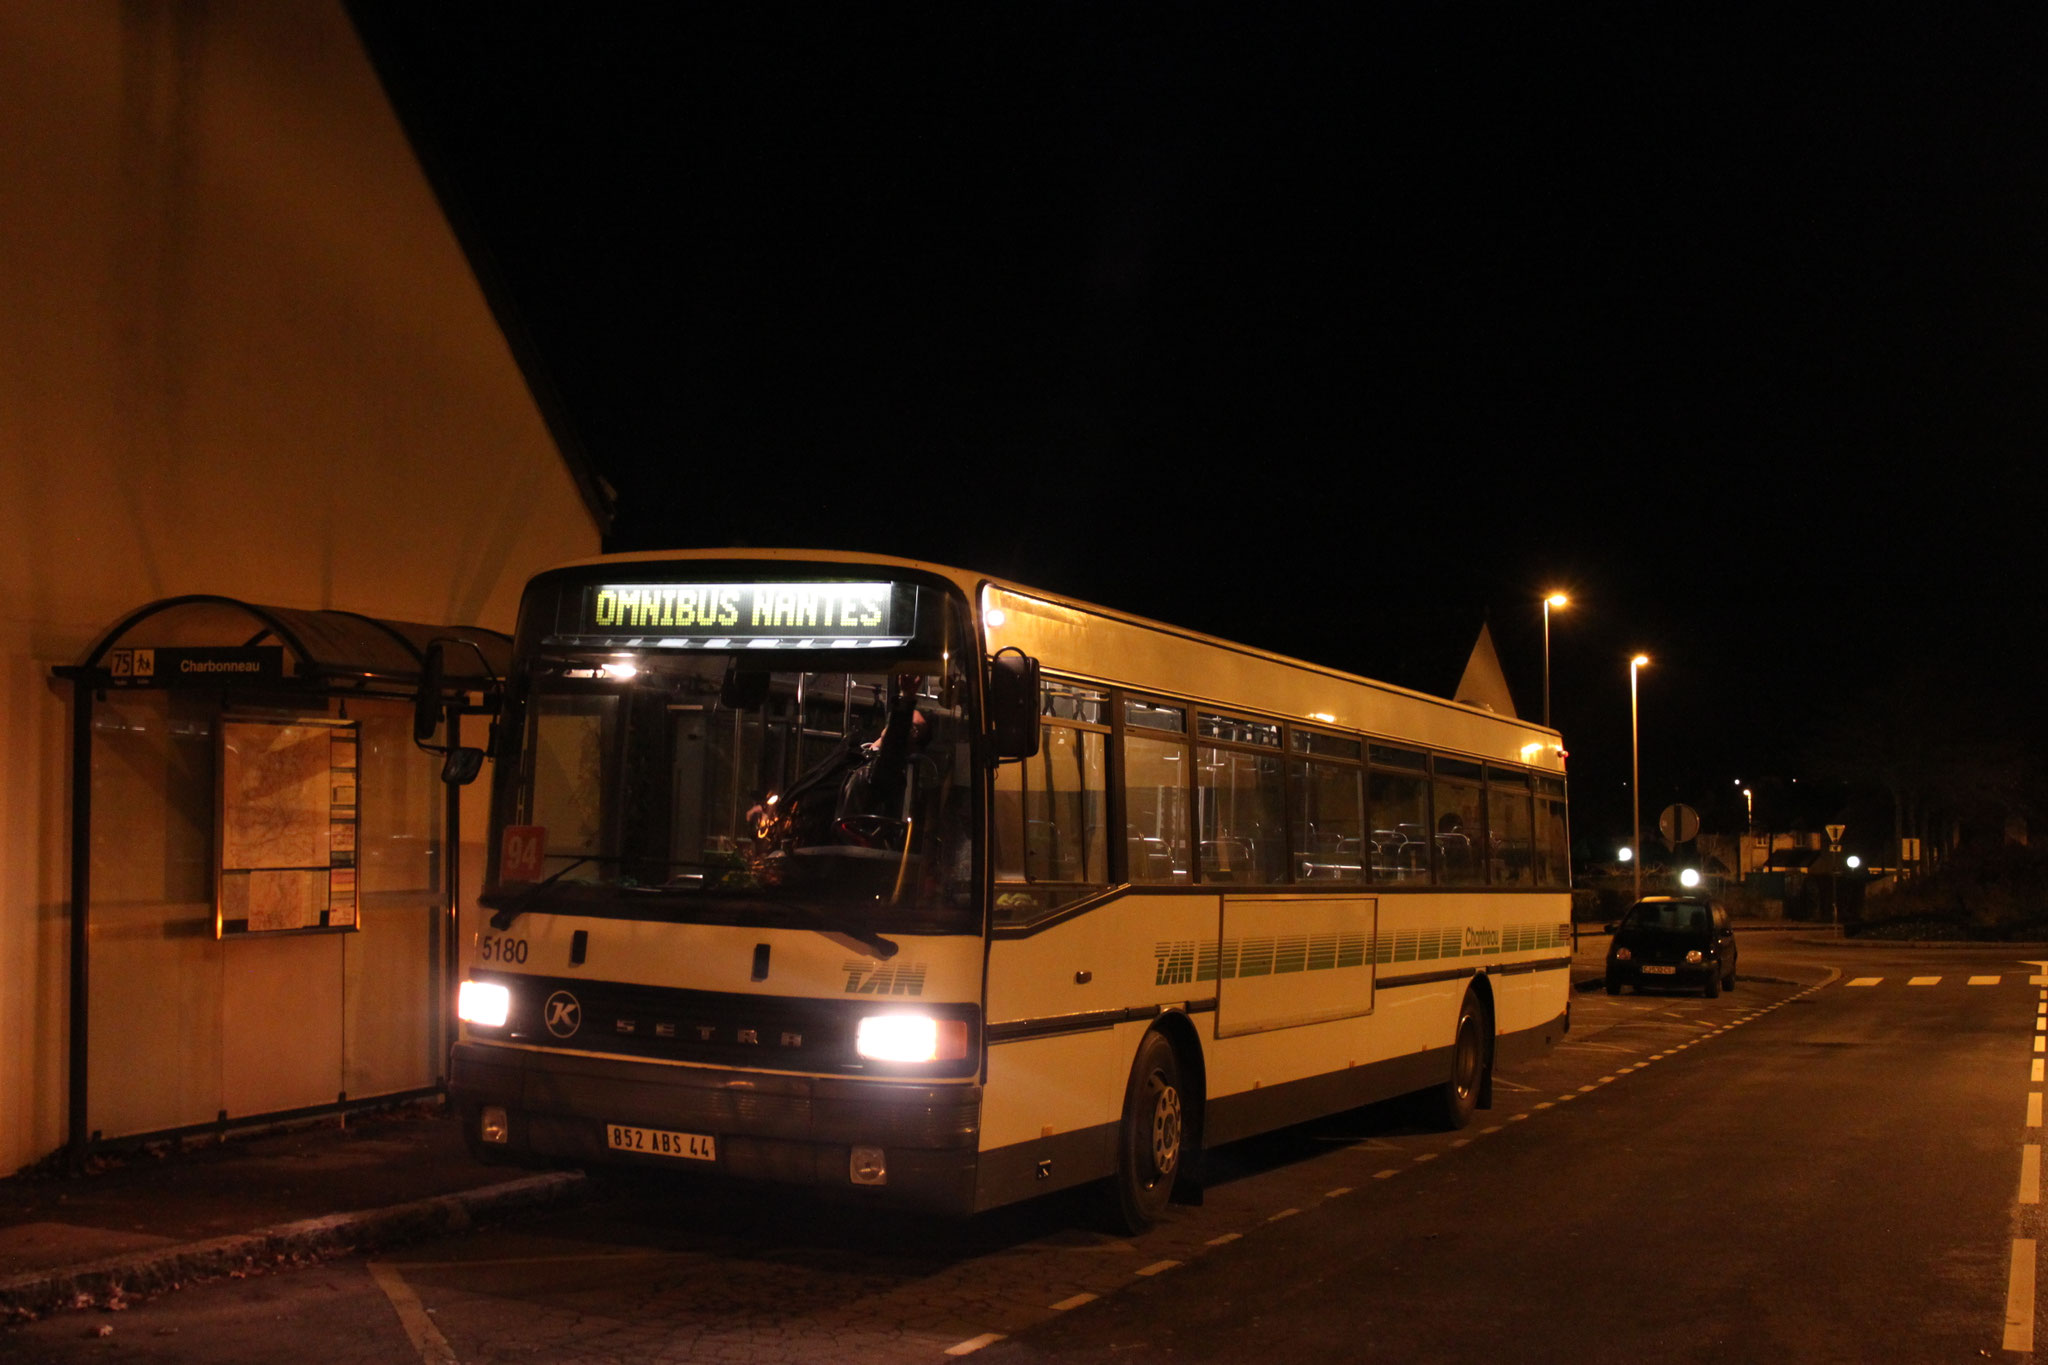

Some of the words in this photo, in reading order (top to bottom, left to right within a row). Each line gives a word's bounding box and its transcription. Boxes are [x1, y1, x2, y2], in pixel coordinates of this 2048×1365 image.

[596, 588, 740, 626] OMNIBUS
[752, 588, 882, 626] NANTES
[115, 653, 131, 674] 75
[180, 659, 261, 673] Charbonneau
[508, 836, 537, 871] 94
[482, 936, 529, 964] 5180
[1154, 941, 1195, 986] TAN
[842, 960, 928, 996] TAN
[616, 1019, 803, 1047] SETRA
[614, 1128, 644, 1149] 852
[652, 1132, 681, 1154] ABS
[690, 1137, 709, 1157] 44
